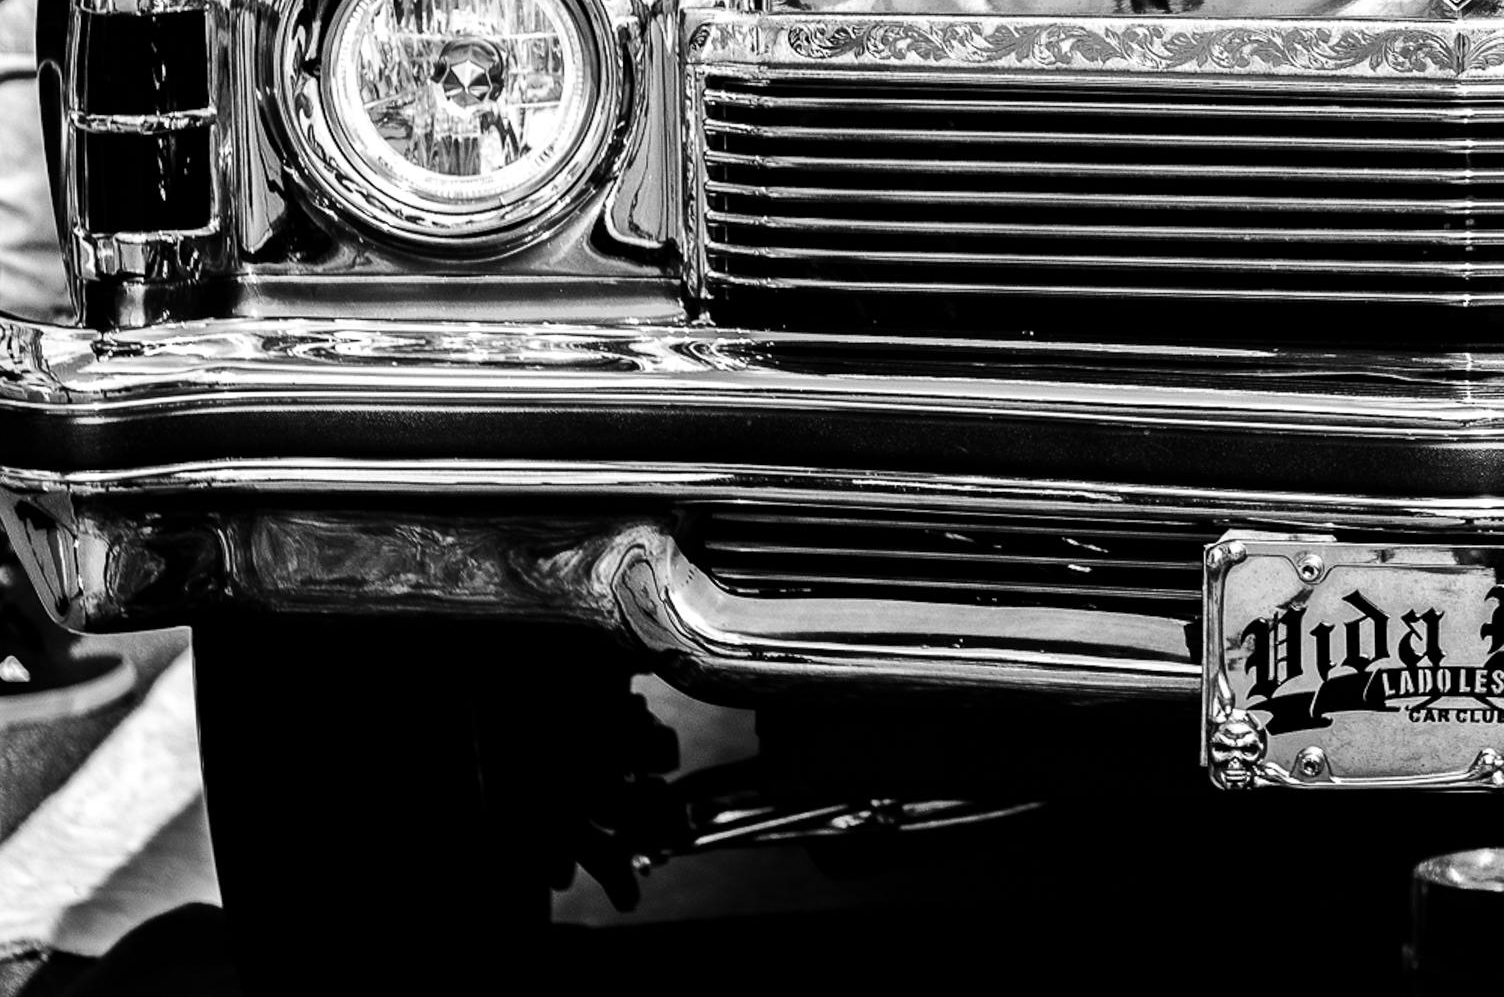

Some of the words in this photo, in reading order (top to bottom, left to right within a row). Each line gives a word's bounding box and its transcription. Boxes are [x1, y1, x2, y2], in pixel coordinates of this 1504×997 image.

[1241, 590, 1447, 699] Vida
[1381, 668, 1452, 698] LADO
[1407, 708, 1451, 723] CAR
